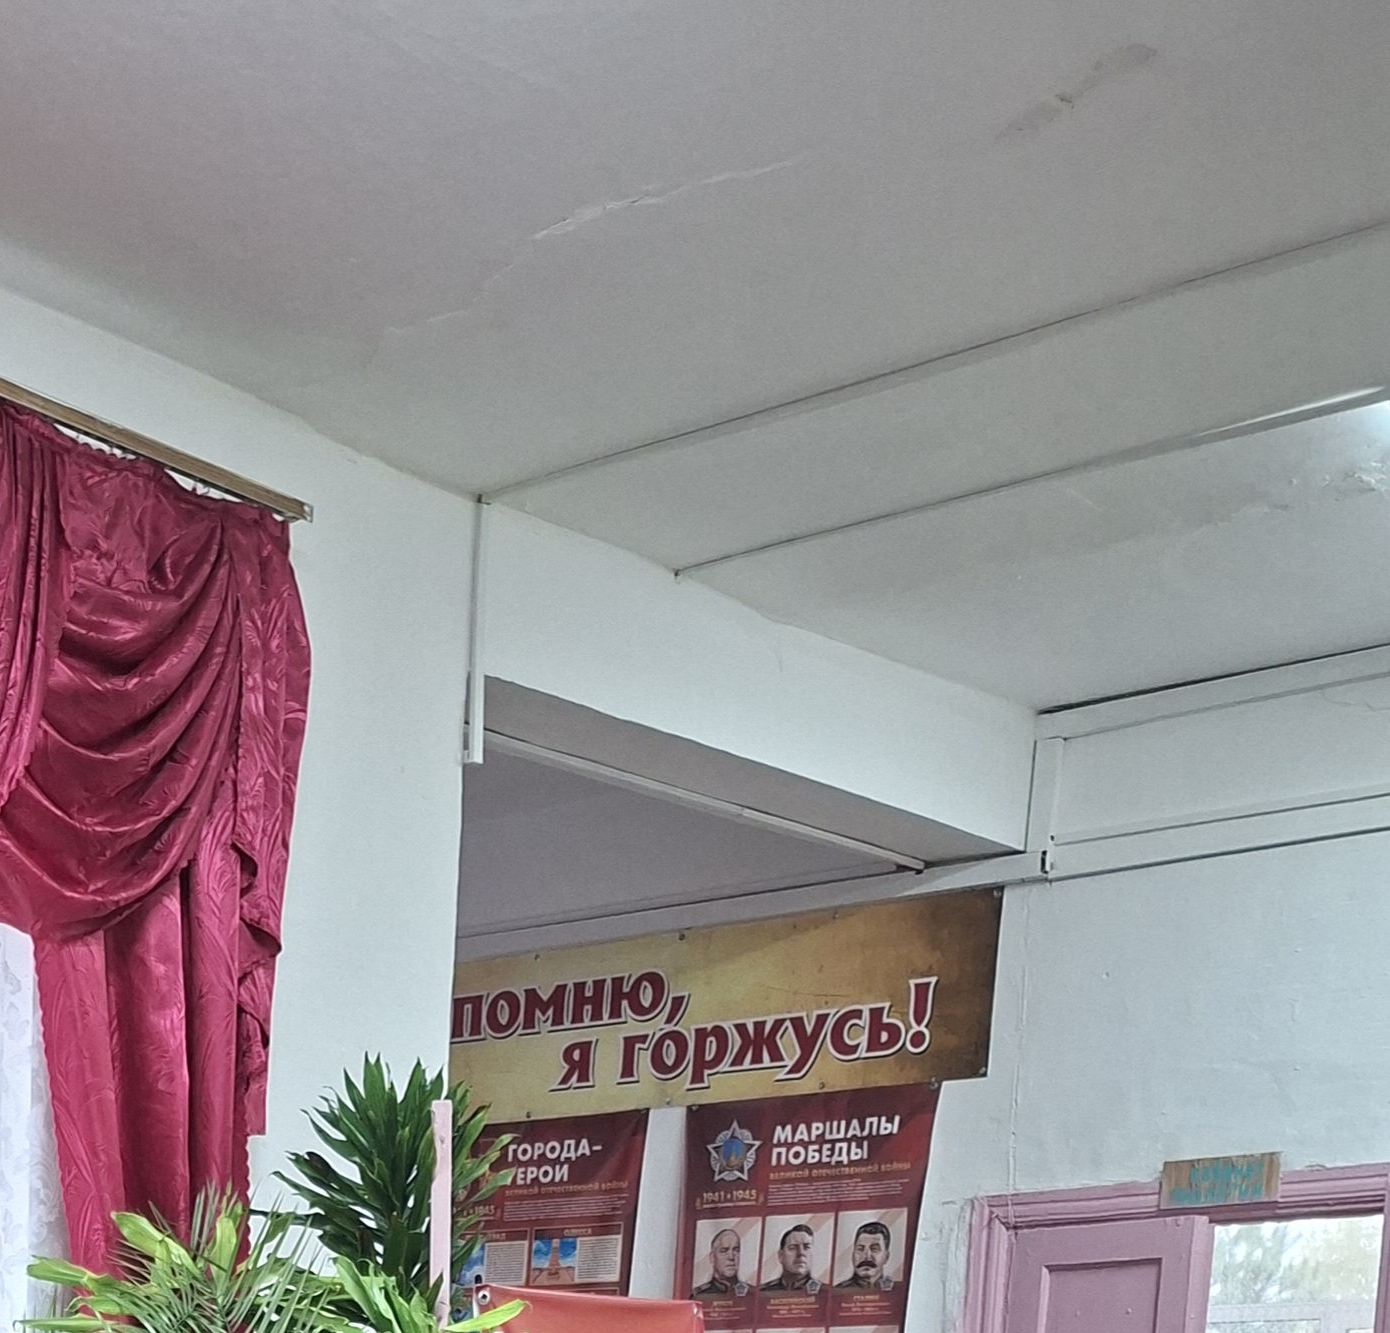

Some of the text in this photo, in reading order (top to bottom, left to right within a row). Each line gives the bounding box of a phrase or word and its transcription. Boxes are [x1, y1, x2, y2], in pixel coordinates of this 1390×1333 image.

[772, 1115, 900, 1144] МАРШАЛЫ
[507, 1138, 602, 1162] ГОРОДА-
[771, 1141, 868, 1166] ПОБЕДЫ
[515, 1164, 569, 1186] ЕРОИ
